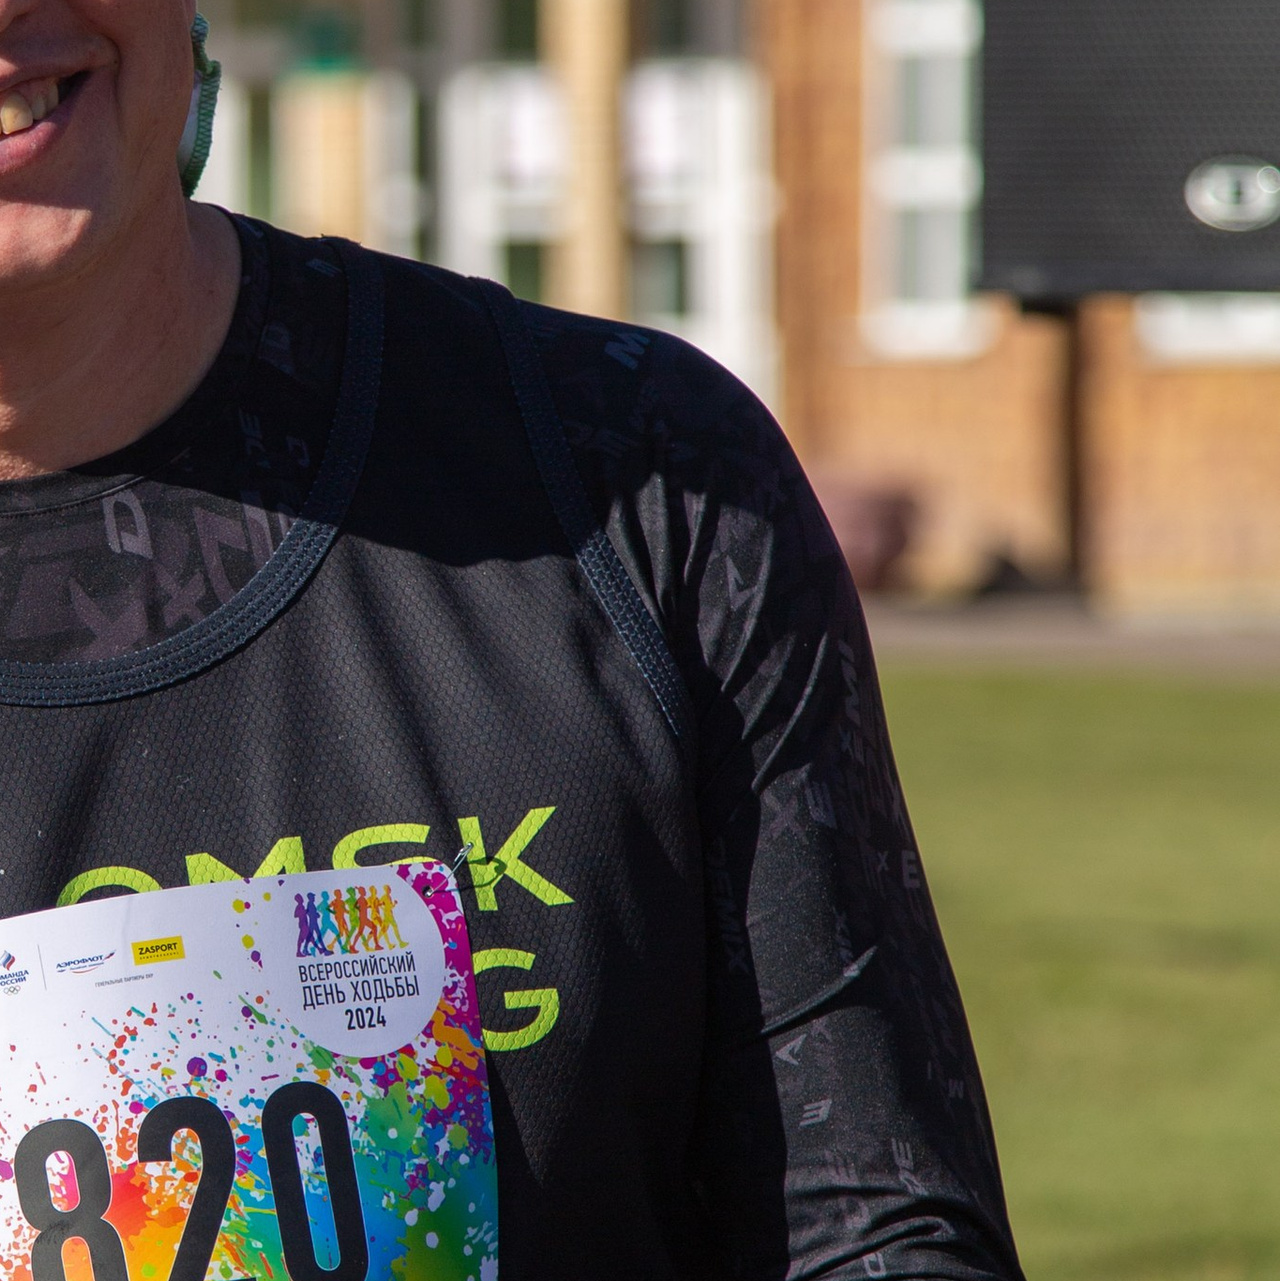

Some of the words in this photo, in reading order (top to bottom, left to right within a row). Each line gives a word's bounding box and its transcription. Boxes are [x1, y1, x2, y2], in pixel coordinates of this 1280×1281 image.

[55, 954, 104, 969] АЭРОФЛОТ
[137, 942, 178, 956] ZASPORT
[298, 951, 417, 983] ВСЕРОССИЙСКИЙ
[302, 982, 346, 1011] ДЕНЬ
[350, 975, 420, 1004] ХОДЬБЫ
[344, 1006, 387, 1031] 2024
